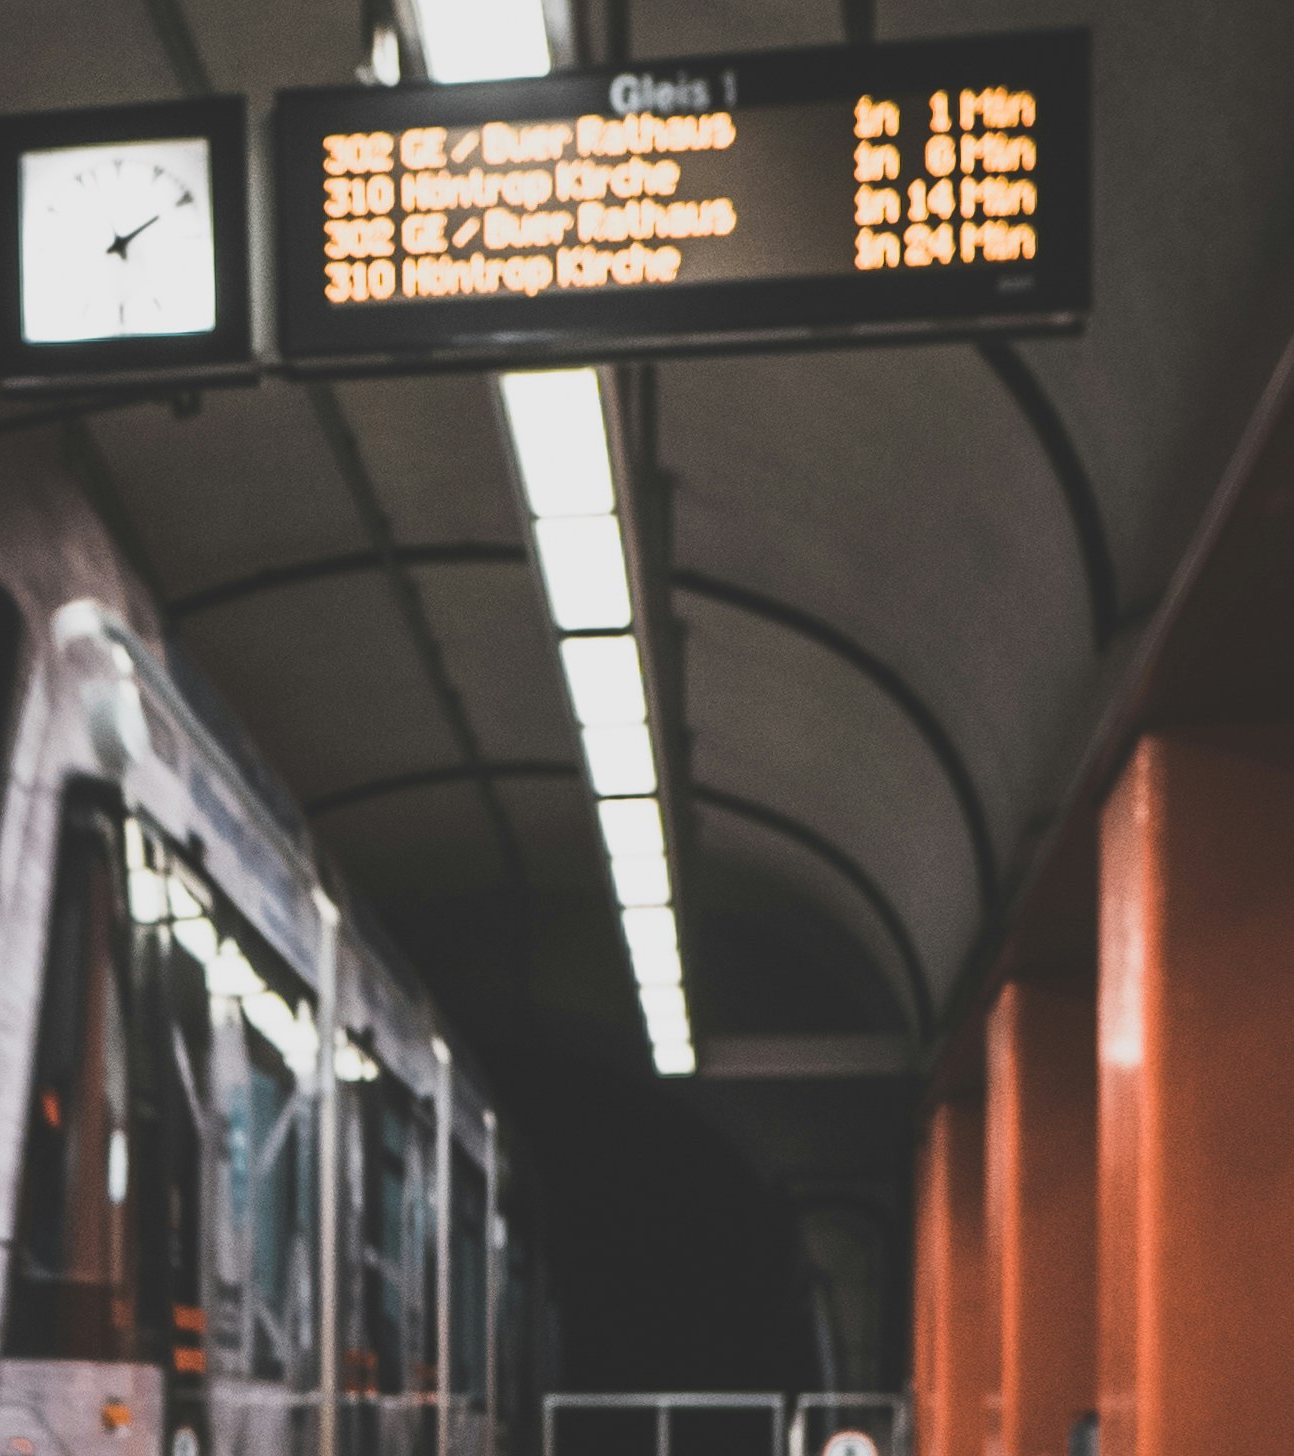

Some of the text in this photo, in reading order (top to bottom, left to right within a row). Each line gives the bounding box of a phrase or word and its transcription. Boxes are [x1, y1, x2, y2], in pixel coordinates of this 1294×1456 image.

[323, 132, 394, 174] 302
[482, 121, 572, 164] Buer
[576, 112, 737, 156] Rathaus
[929, 89, 952, 133] 1
[959, 85, 1036, 131] Min
[609, 71, 710, 114] Gleis
[323, 174, 395, 218] 310
[555, 156, 680, 201] Kirche
[960, 130, 1037, 174] Min
[323, 216, 395, 260] 302
[483, 207, 574, 250] Buer
[576, 198, 738, 243] Rathaus
[907, 177, 956, 222] 14
[960, 173, 1037, 219] Min
[323, 259, 395, 303] 310
[556, 242, 681, 287] Kirche
[903, 221, 956, 266] 24
[960, 218, 1037, 263] Min
